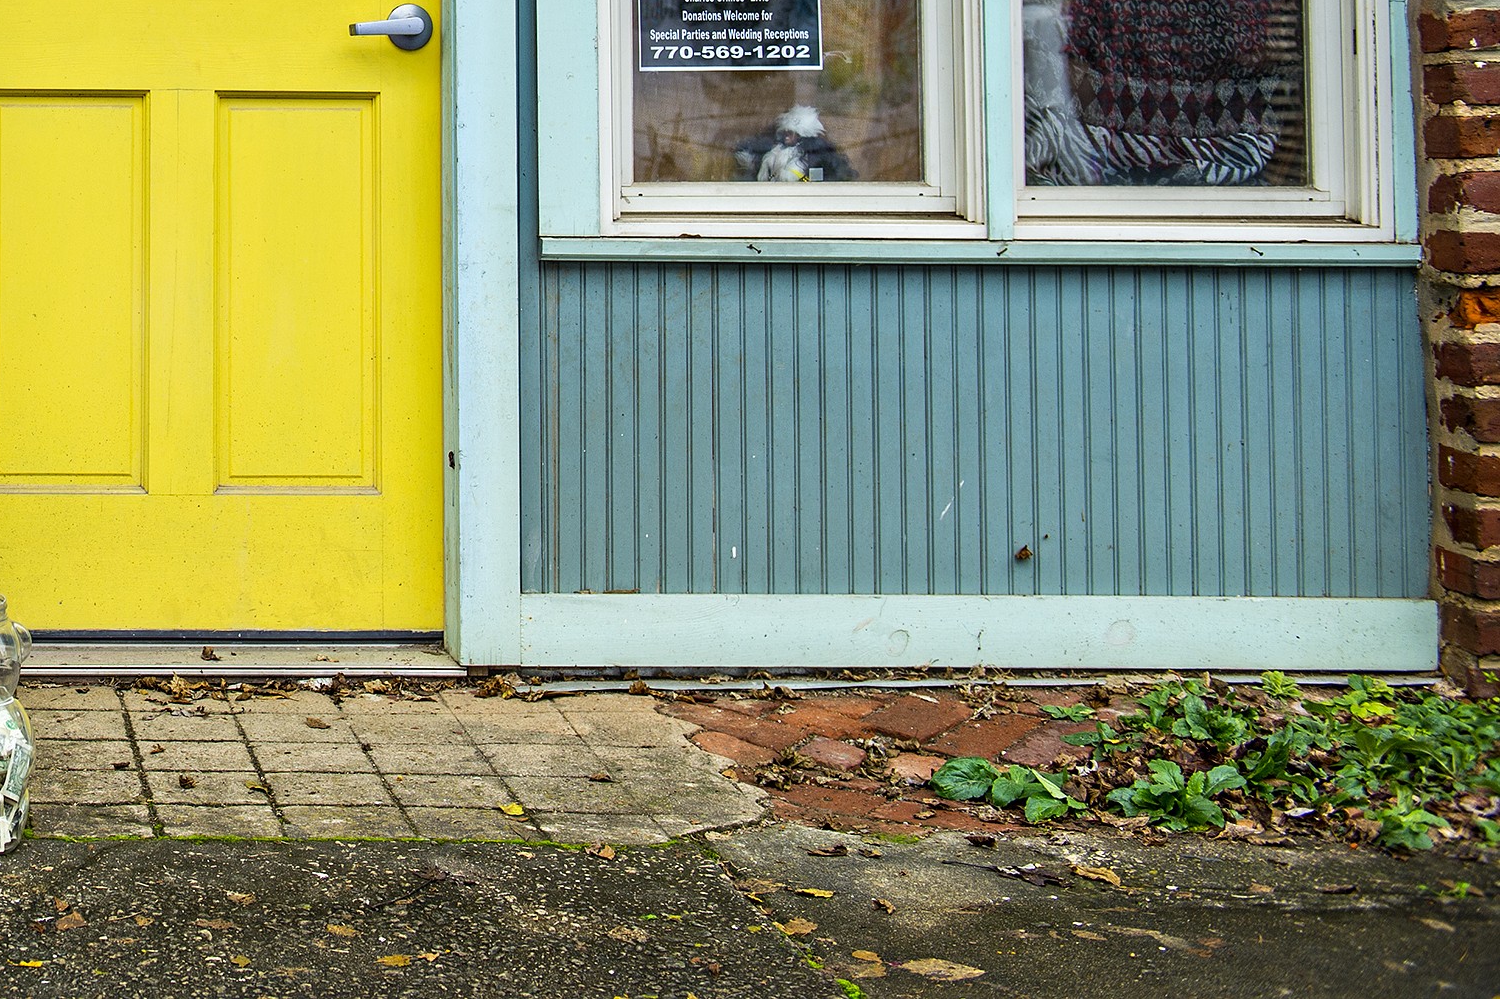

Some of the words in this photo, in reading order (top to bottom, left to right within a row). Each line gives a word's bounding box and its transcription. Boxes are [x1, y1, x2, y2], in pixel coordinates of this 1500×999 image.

[682, 10, 721, 22] Donations
[723, 10, 760, 21] Welcome
[761, 10, 773, 21] for
[650, 29, 680, 42] Special
[681, 29, 710, 40] Parties
[712, 30, 726, 40] and
[728, 29, 762, 42] Wedding
[764, 29, 809, 41] Receptions
[650, 45, 811, 59] 770-569-1202
